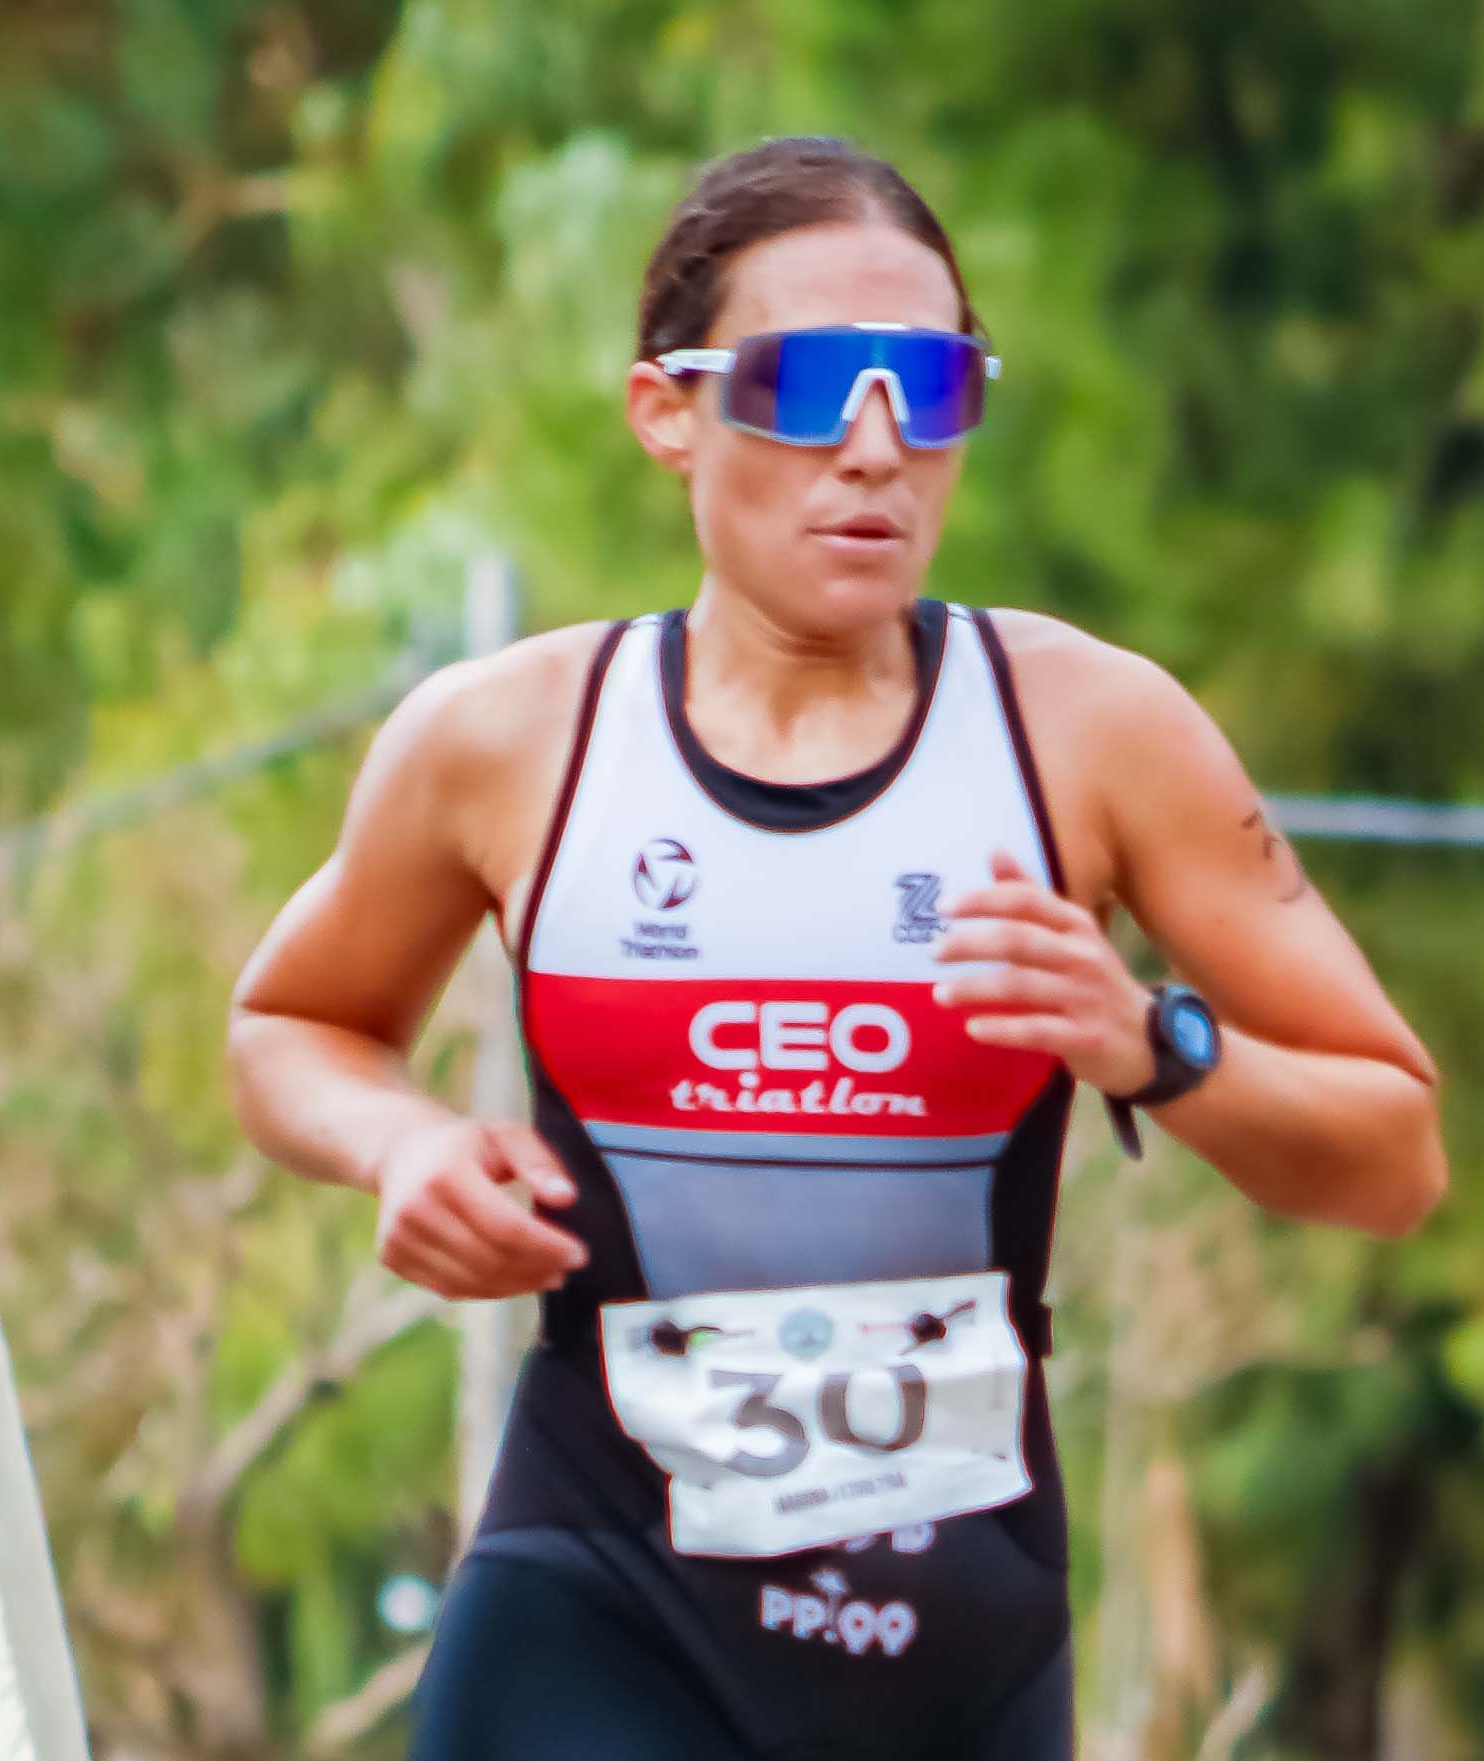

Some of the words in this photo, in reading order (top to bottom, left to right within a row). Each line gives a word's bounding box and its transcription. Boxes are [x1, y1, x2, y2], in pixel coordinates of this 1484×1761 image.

[689, 1001, 912, 1073] CEO
[669, 1071, 928, 1117] triatlon
[708, 1363, 929, 1478] 30
